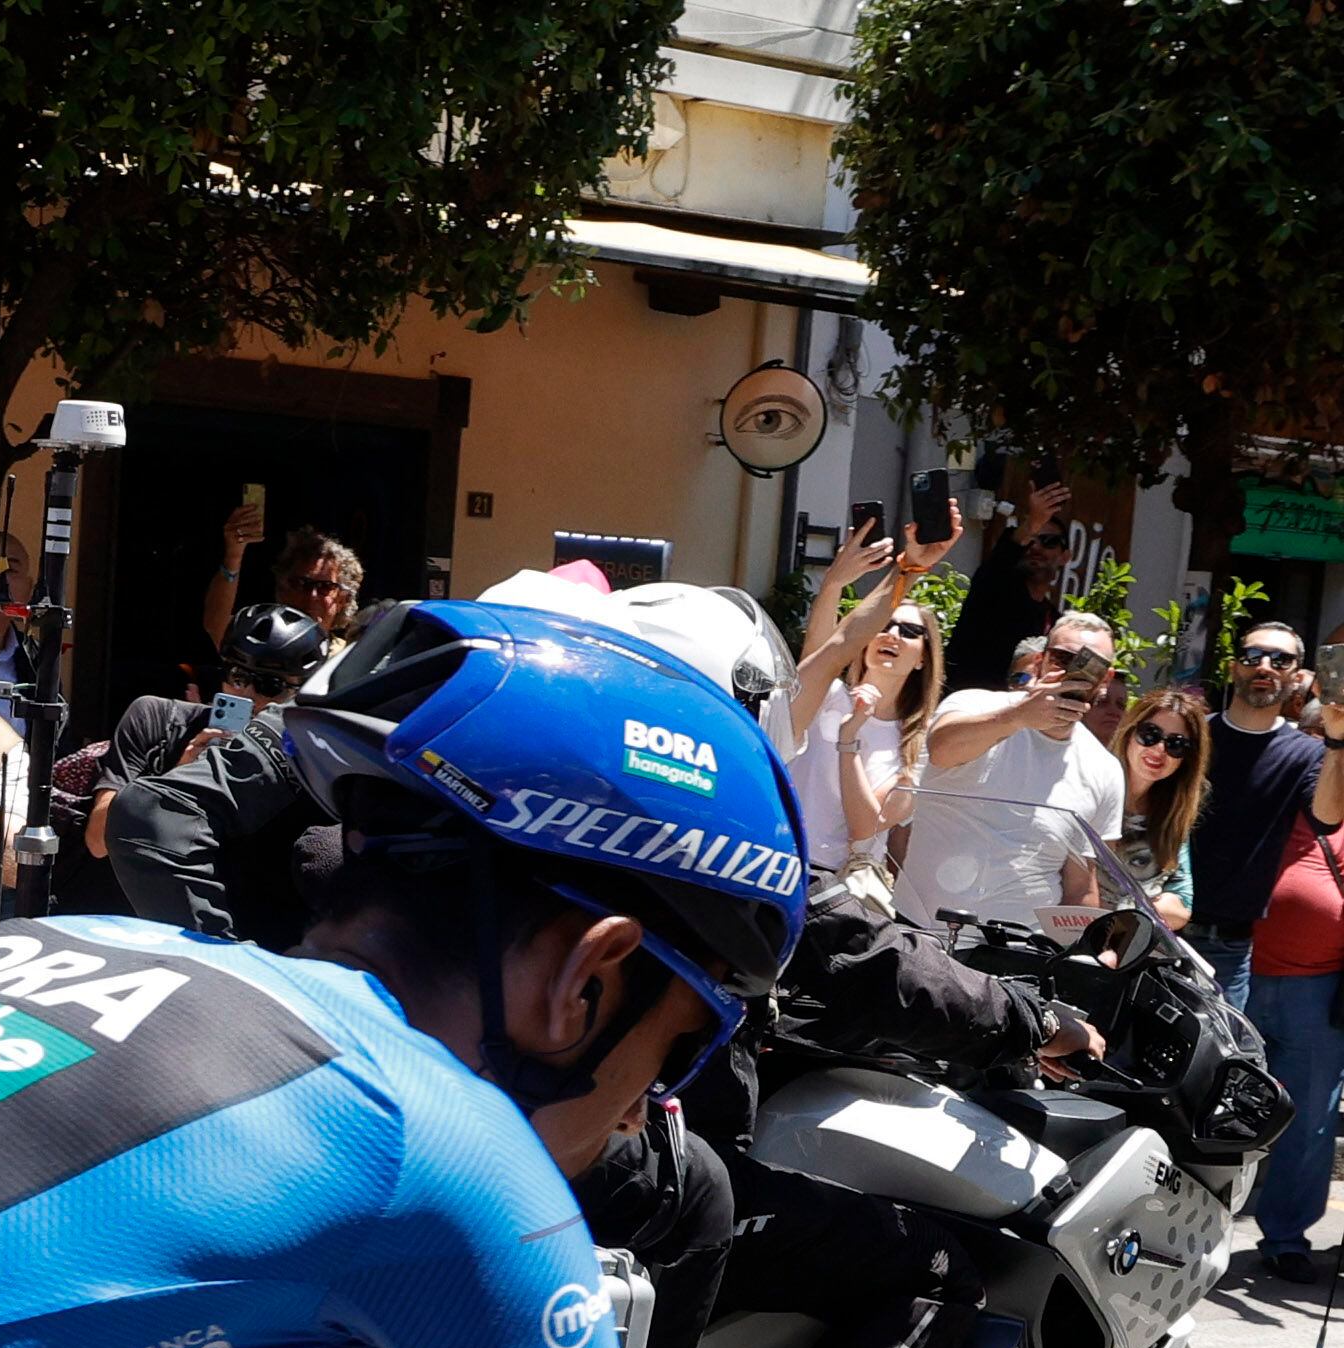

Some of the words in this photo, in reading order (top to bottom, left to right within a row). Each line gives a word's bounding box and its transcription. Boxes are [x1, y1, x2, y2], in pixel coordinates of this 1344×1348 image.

[473, 495, 490, 514] 21
[623, 718, 719, 773] BORA
[432, 767, 490, 813] MARTINEZ
[628, 749, 714, 792] hansgrohe
[484, 787, 803, 897] SPECIALIZED
[1154, 1160, 1183, 1196] EMG
